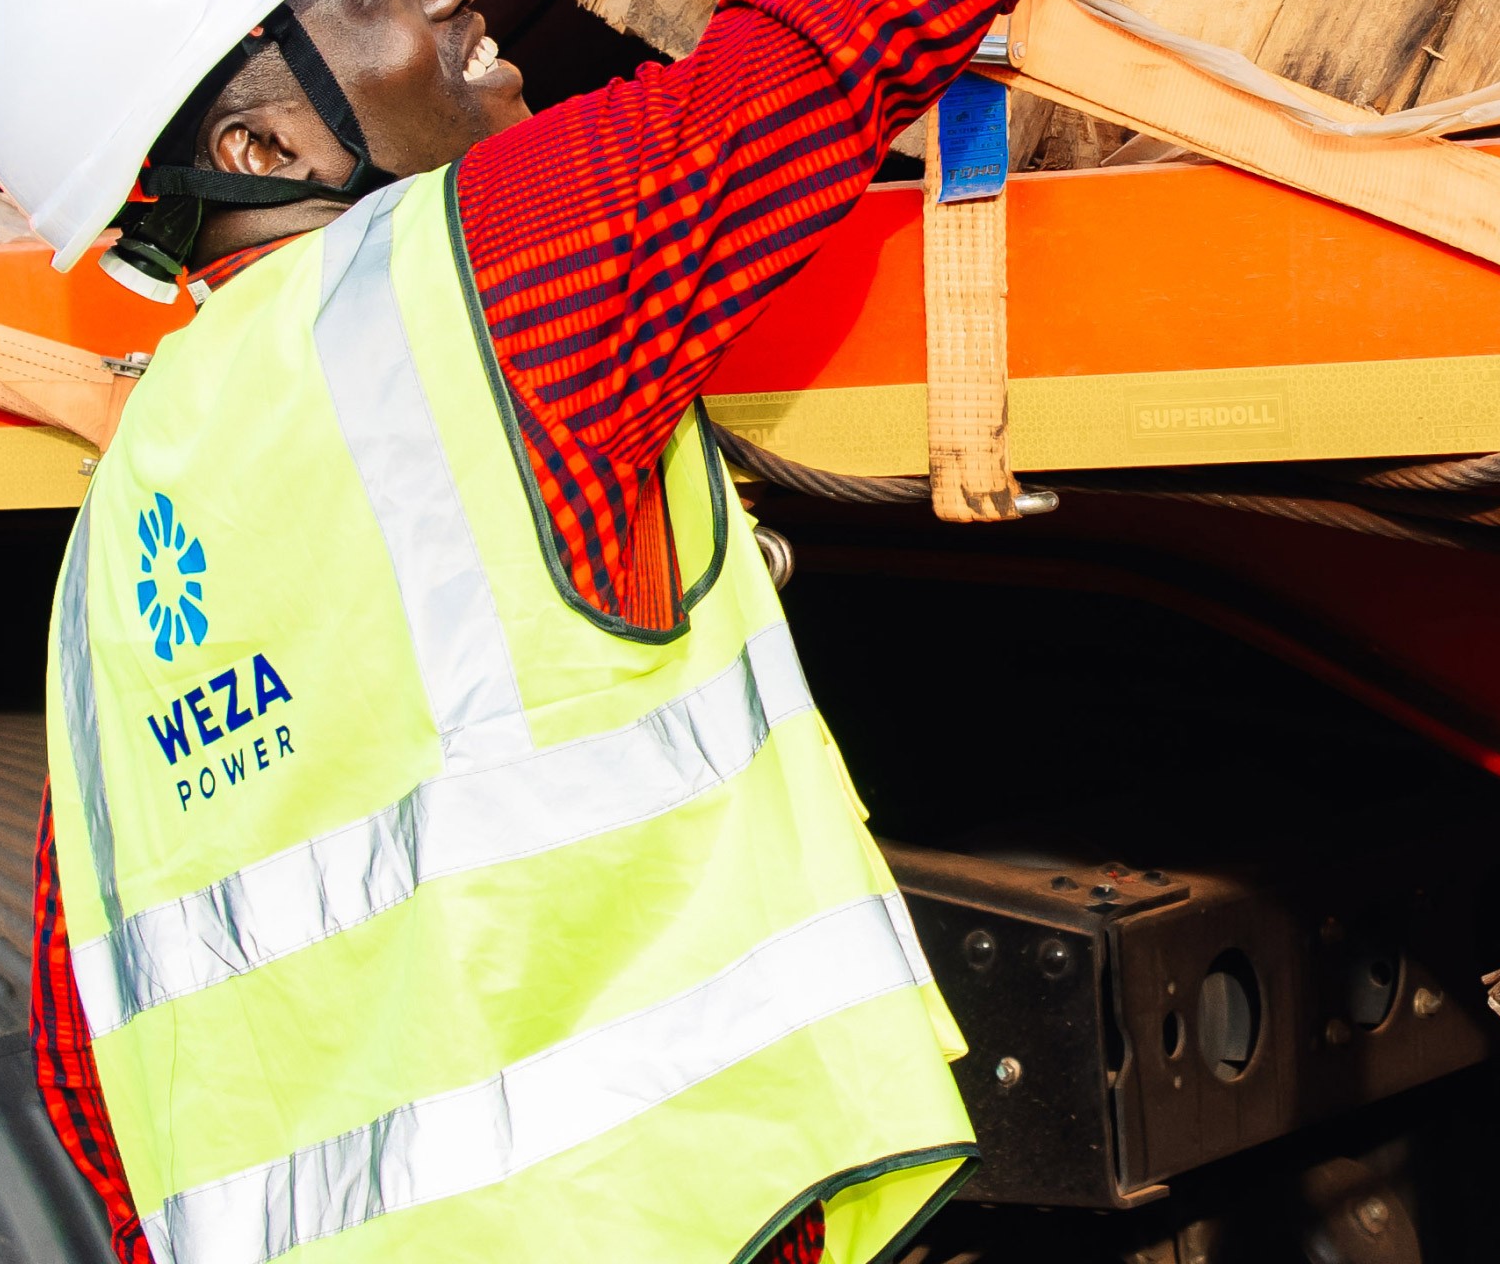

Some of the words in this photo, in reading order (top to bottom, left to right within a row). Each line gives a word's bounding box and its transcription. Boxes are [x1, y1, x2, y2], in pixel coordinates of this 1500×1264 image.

[1137, 403, 1276, 431] SUPERDOLL
[146, 652, 293, 767] WEZA
[177, 724, 296, 813] POWER
